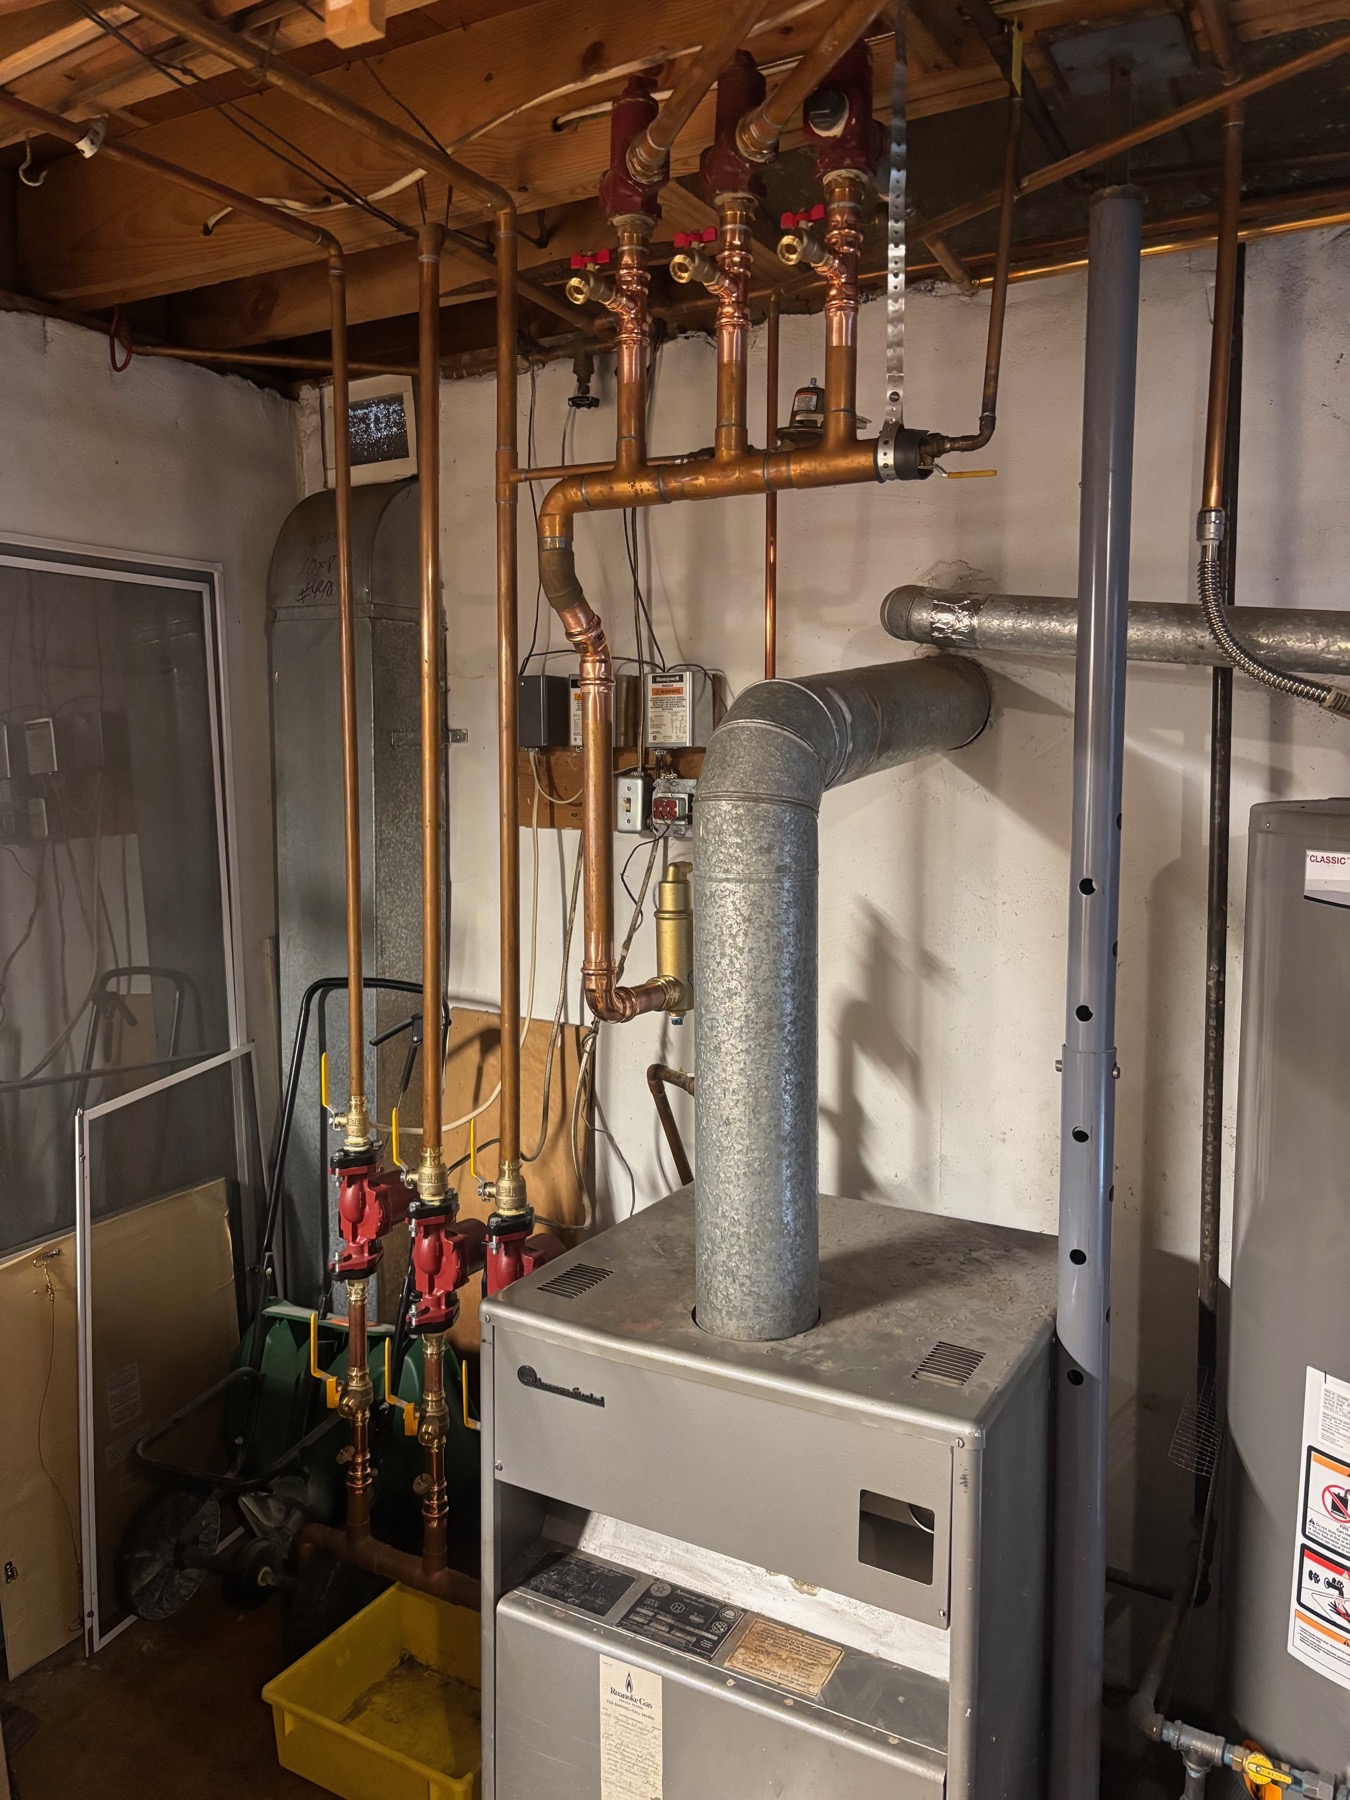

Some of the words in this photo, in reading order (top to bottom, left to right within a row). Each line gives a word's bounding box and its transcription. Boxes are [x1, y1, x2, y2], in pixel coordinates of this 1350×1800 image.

[1310, 854, 1346, 865] CLASSIC
[610, 1686, 638, 1704] Roanoke
[639, 1698, 652, 1709] Gas
